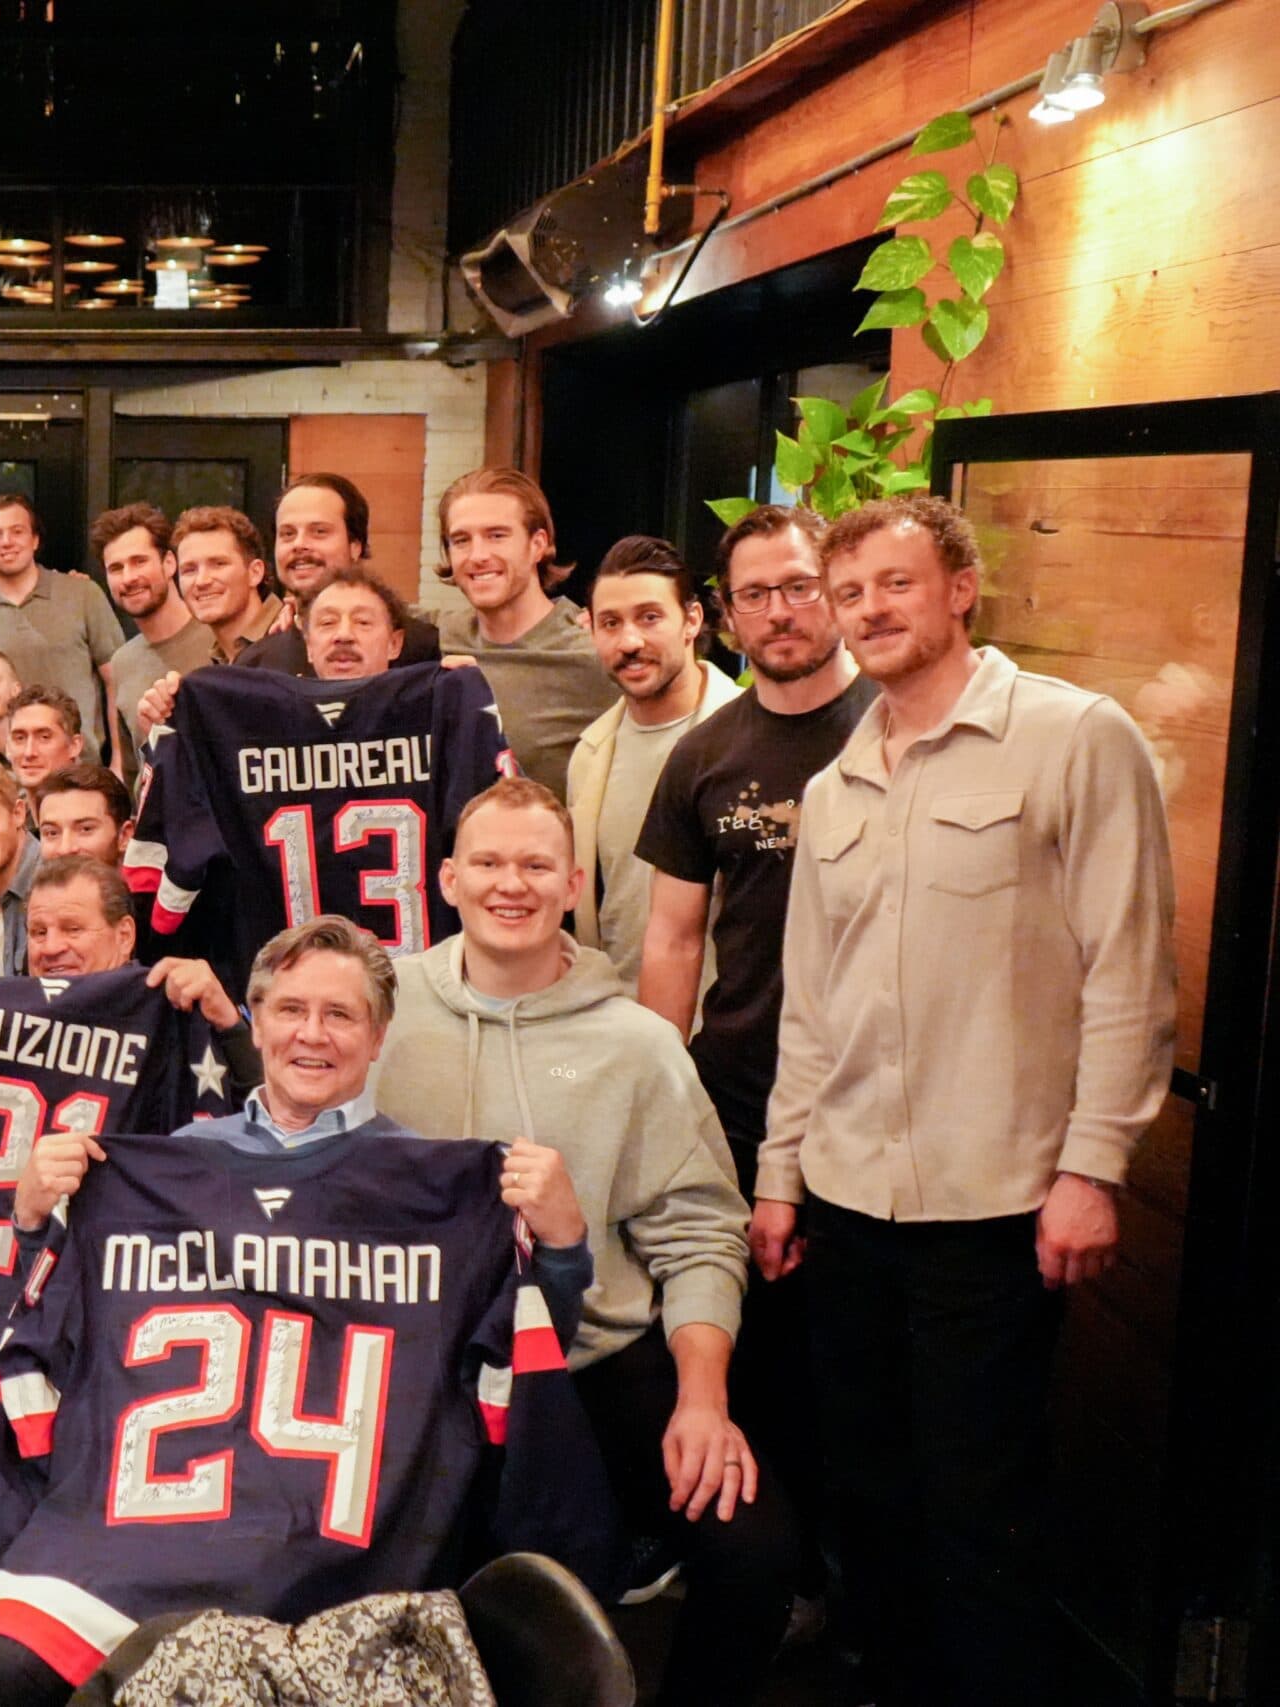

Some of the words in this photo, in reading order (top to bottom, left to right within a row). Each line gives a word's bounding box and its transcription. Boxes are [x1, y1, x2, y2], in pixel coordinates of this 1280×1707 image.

[238, 735, 432, 794] GAUDREAU
[717, 810, 764, 833] rag
[255, 799, 430, 957] 13
[103, 1231, 442, 1303] McCLANAHAN
[106, 1303, 395, 1549] 24
